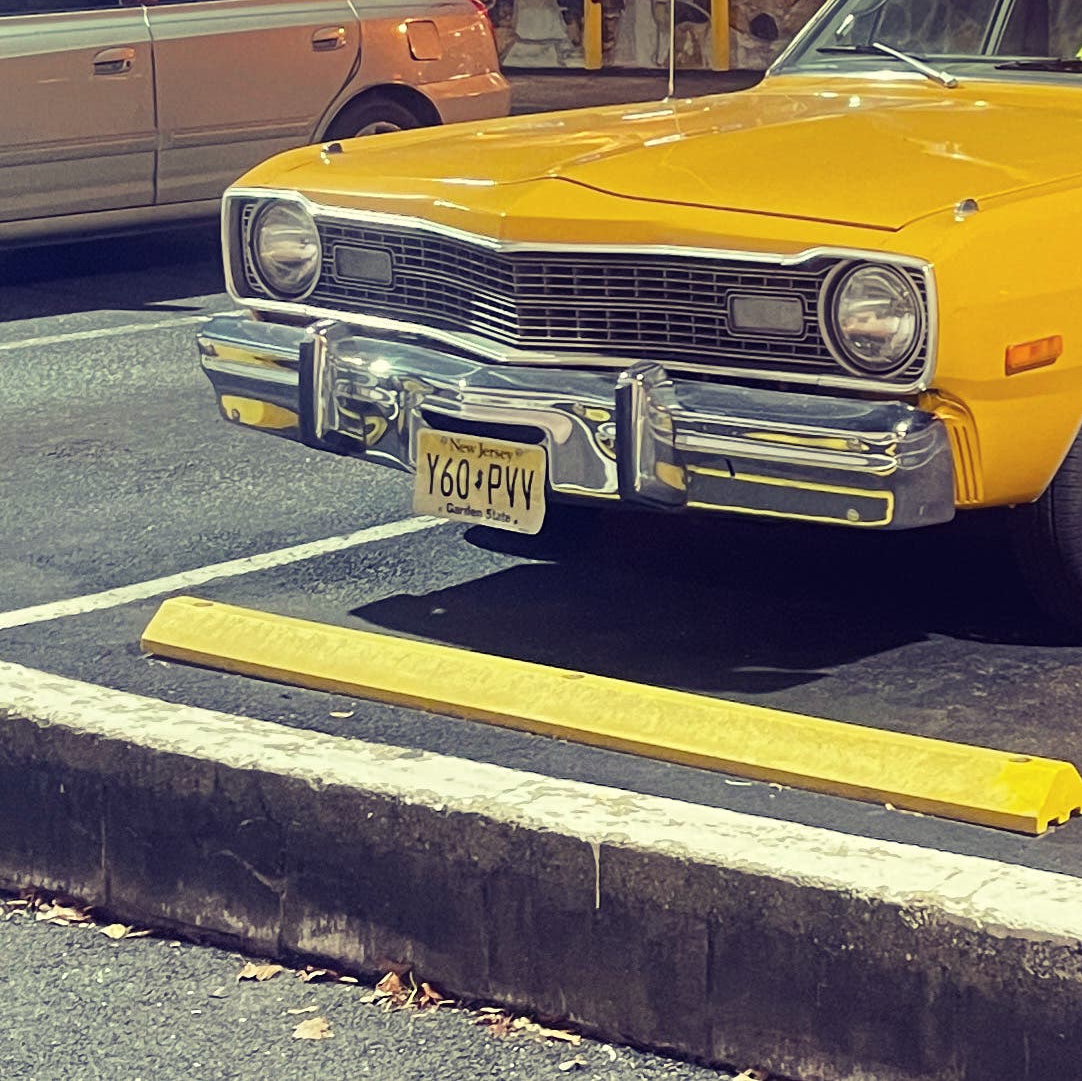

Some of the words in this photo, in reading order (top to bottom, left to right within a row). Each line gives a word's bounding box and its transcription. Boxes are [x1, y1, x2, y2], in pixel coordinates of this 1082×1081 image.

[450, 438, 475, 453] New
[478, 442, 513, 461] Jersey
[446, 502, 483, 517] Garden
[486, 508, 511, 523] State
